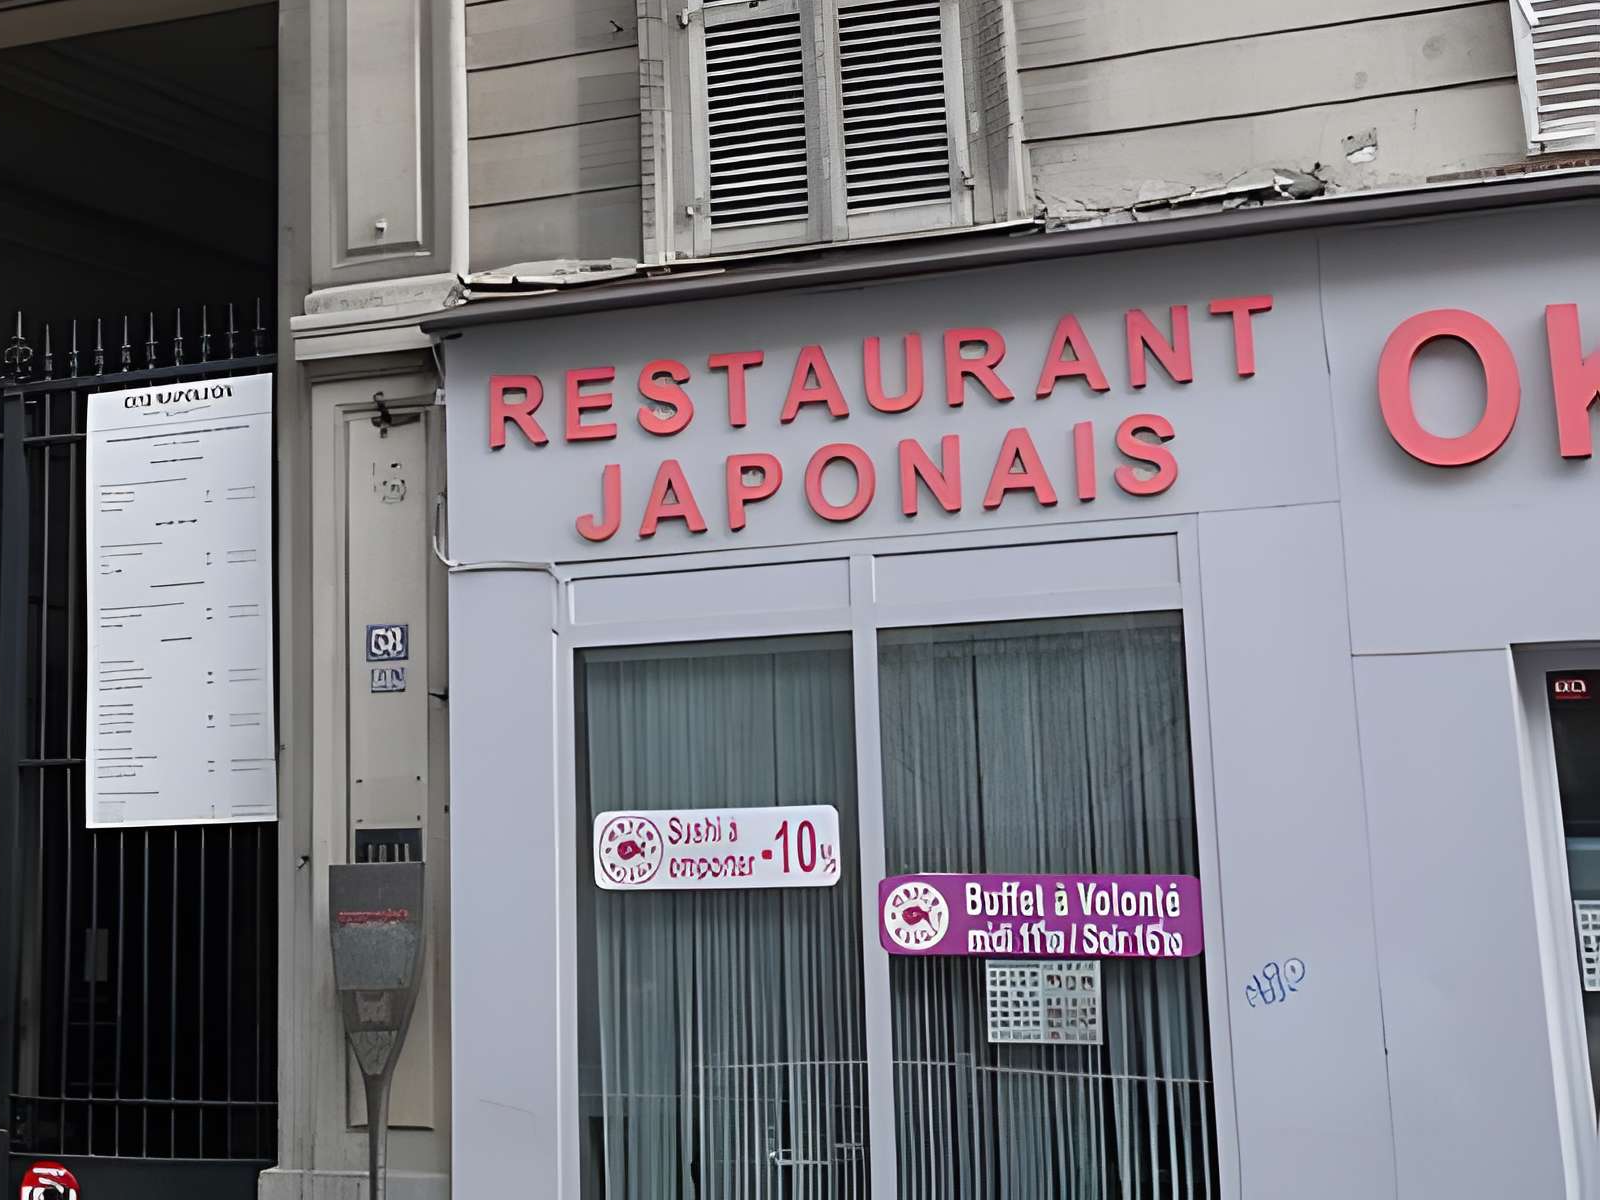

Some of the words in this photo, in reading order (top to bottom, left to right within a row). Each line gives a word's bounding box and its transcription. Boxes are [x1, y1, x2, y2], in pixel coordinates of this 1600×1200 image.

[489, 294, 1274, 449] RESTAURANT
[575, 413, 1180, 542] JAPONAIS
[965, 881, 1046, 918] Buffet
[1076, 881, 1181, 919] Volonté
